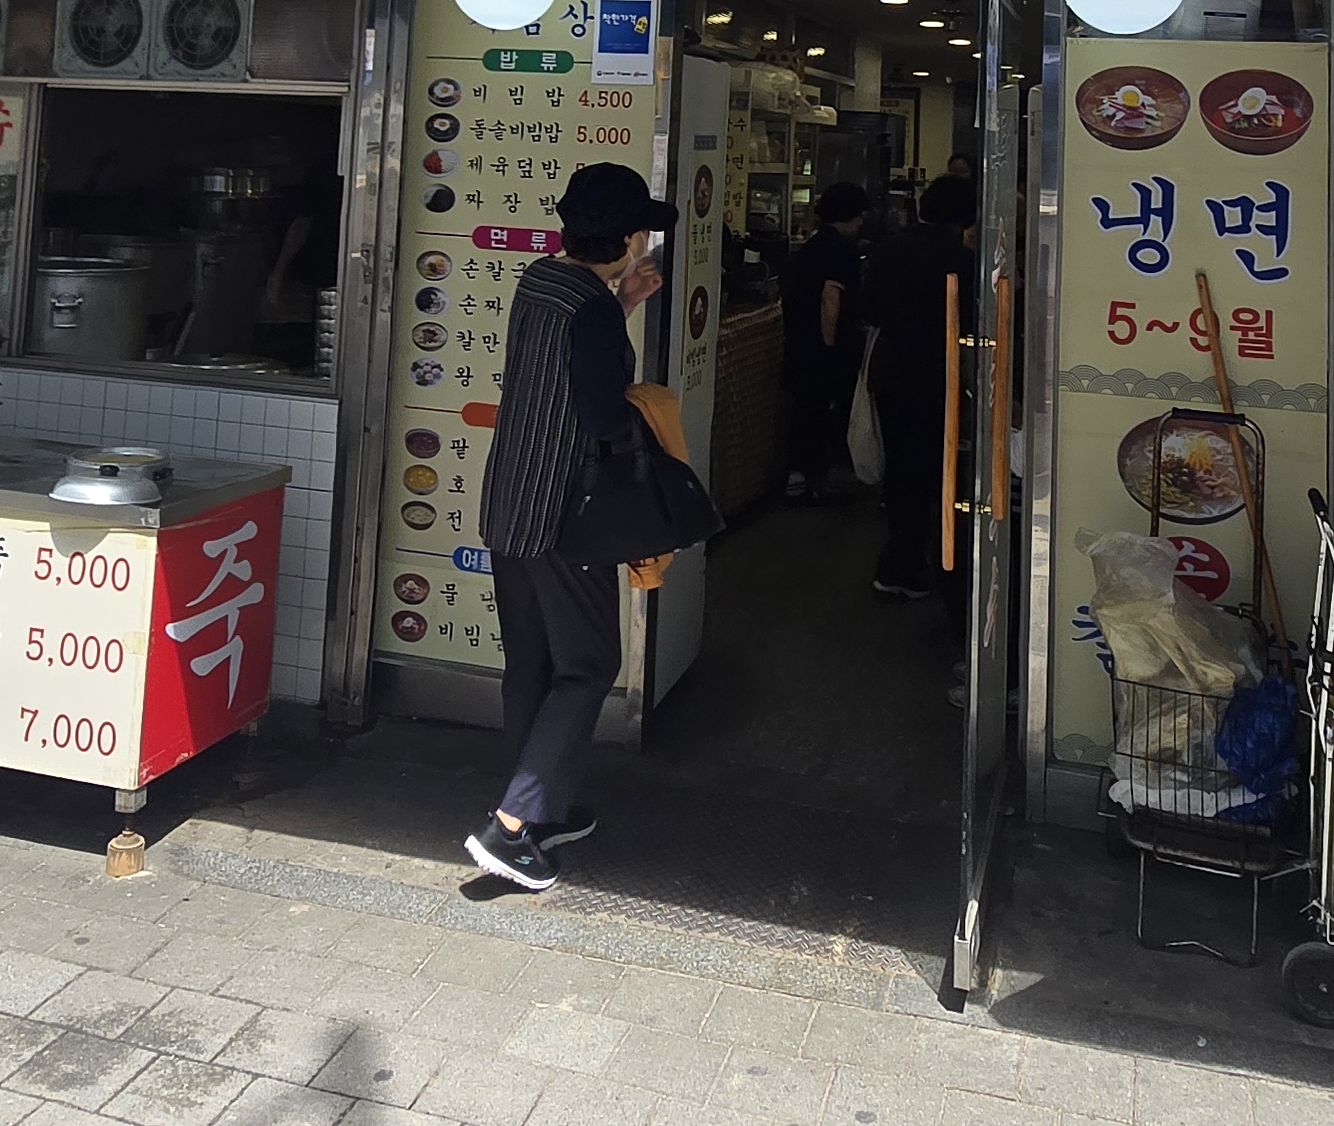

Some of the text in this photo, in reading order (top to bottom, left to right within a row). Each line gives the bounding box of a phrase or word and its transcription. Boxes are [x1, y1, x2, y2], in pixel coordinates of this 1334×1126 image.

[578, 90, 633, 109] 4,500
[469, 118, 632, 146] 돌솥비빔밥 5,000
[33, 546, 131, 592] 5,000
[163, 519, 266, 711] 죽
[25, 627, 124, 674] 5,000
[19, 706, 117, 756] 7,000
